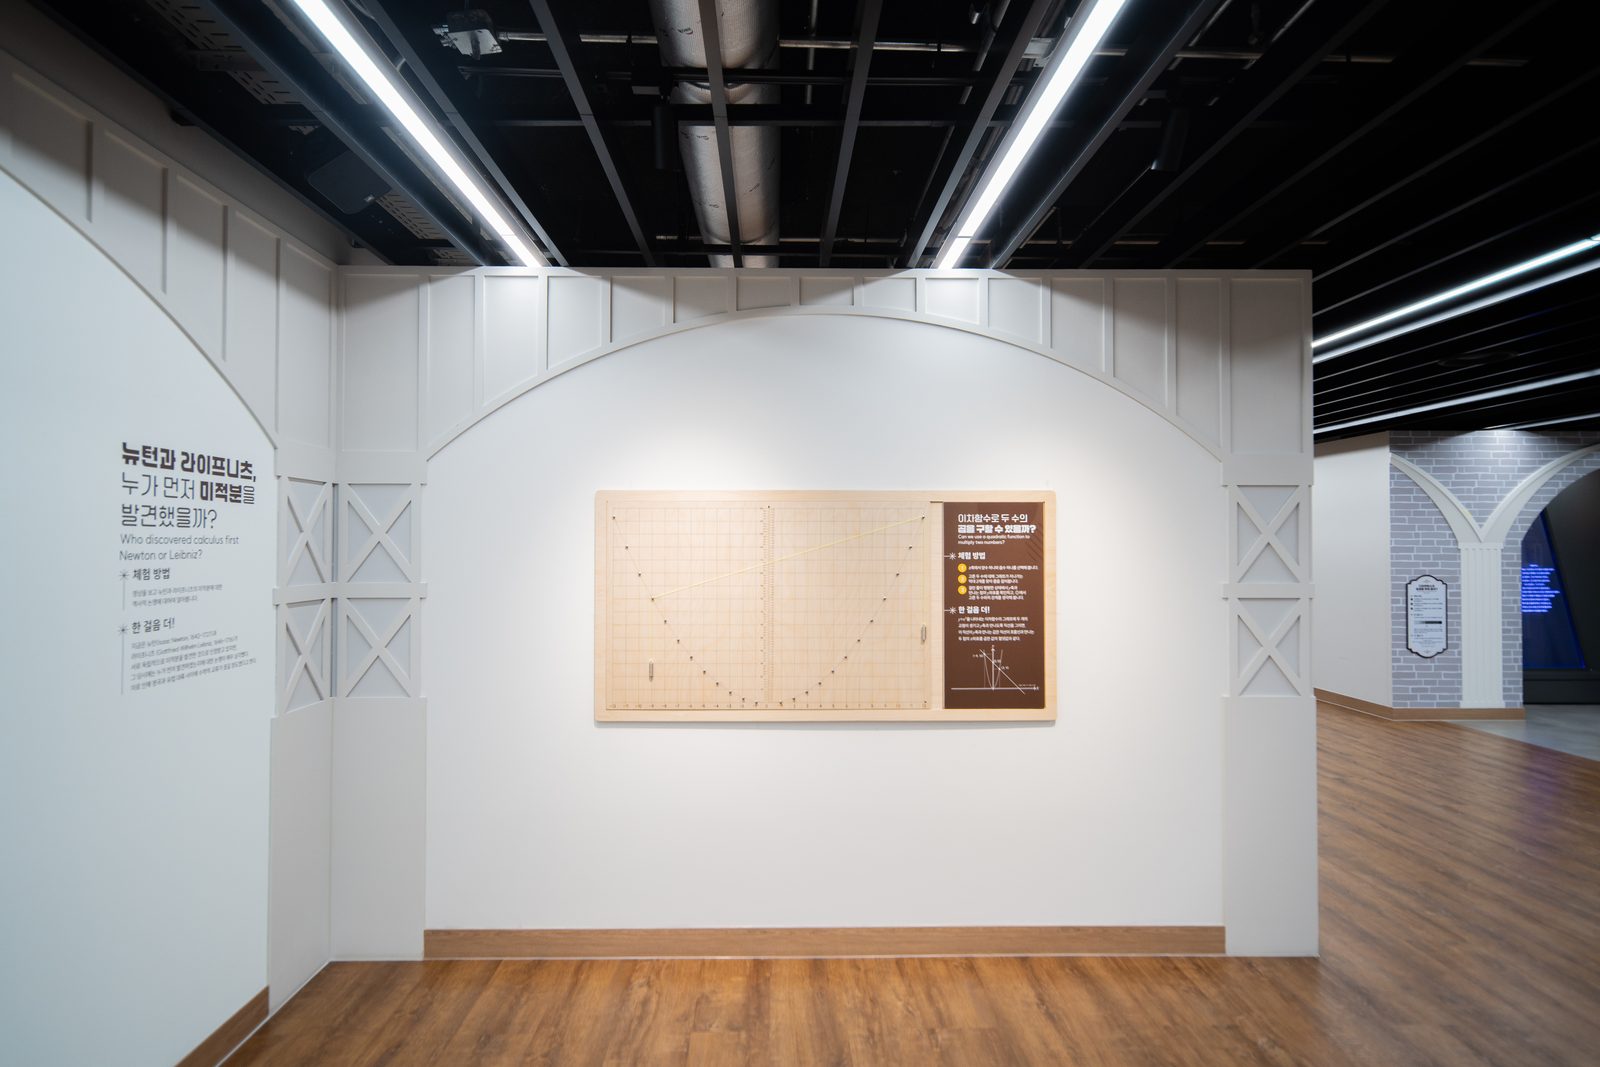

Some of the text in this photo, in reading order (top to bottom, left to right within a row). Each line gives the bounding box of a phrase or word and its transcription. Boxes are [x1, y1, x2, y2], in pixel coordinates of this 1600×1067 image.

[122, 442, 256, 482] 뉴턴과 라이프니츠,
[122, 472, 255, 505] 누가 먼저 미적분을
[121, 503, 217, 529] 발견했을까?
[958, 514, 1028, 523] 이차함수로 두 수의
[976, 524, 993, 533] 구할
[994, 524, 1003, 533] 수
[120, 534, 143, 544] Who
[145, 535, 192, 545] discovered
[193, 536, 223, 545] calculus
[119, 549, 203, 560] Newton or Leibniz?
[972, 552, 986, 560] 방법
[132, 568, 170, 580] 체험 방법
[958, 606, 990, 614] 한 걸음 더!
[132, 617, 175, 634] 한 걸음 더!
